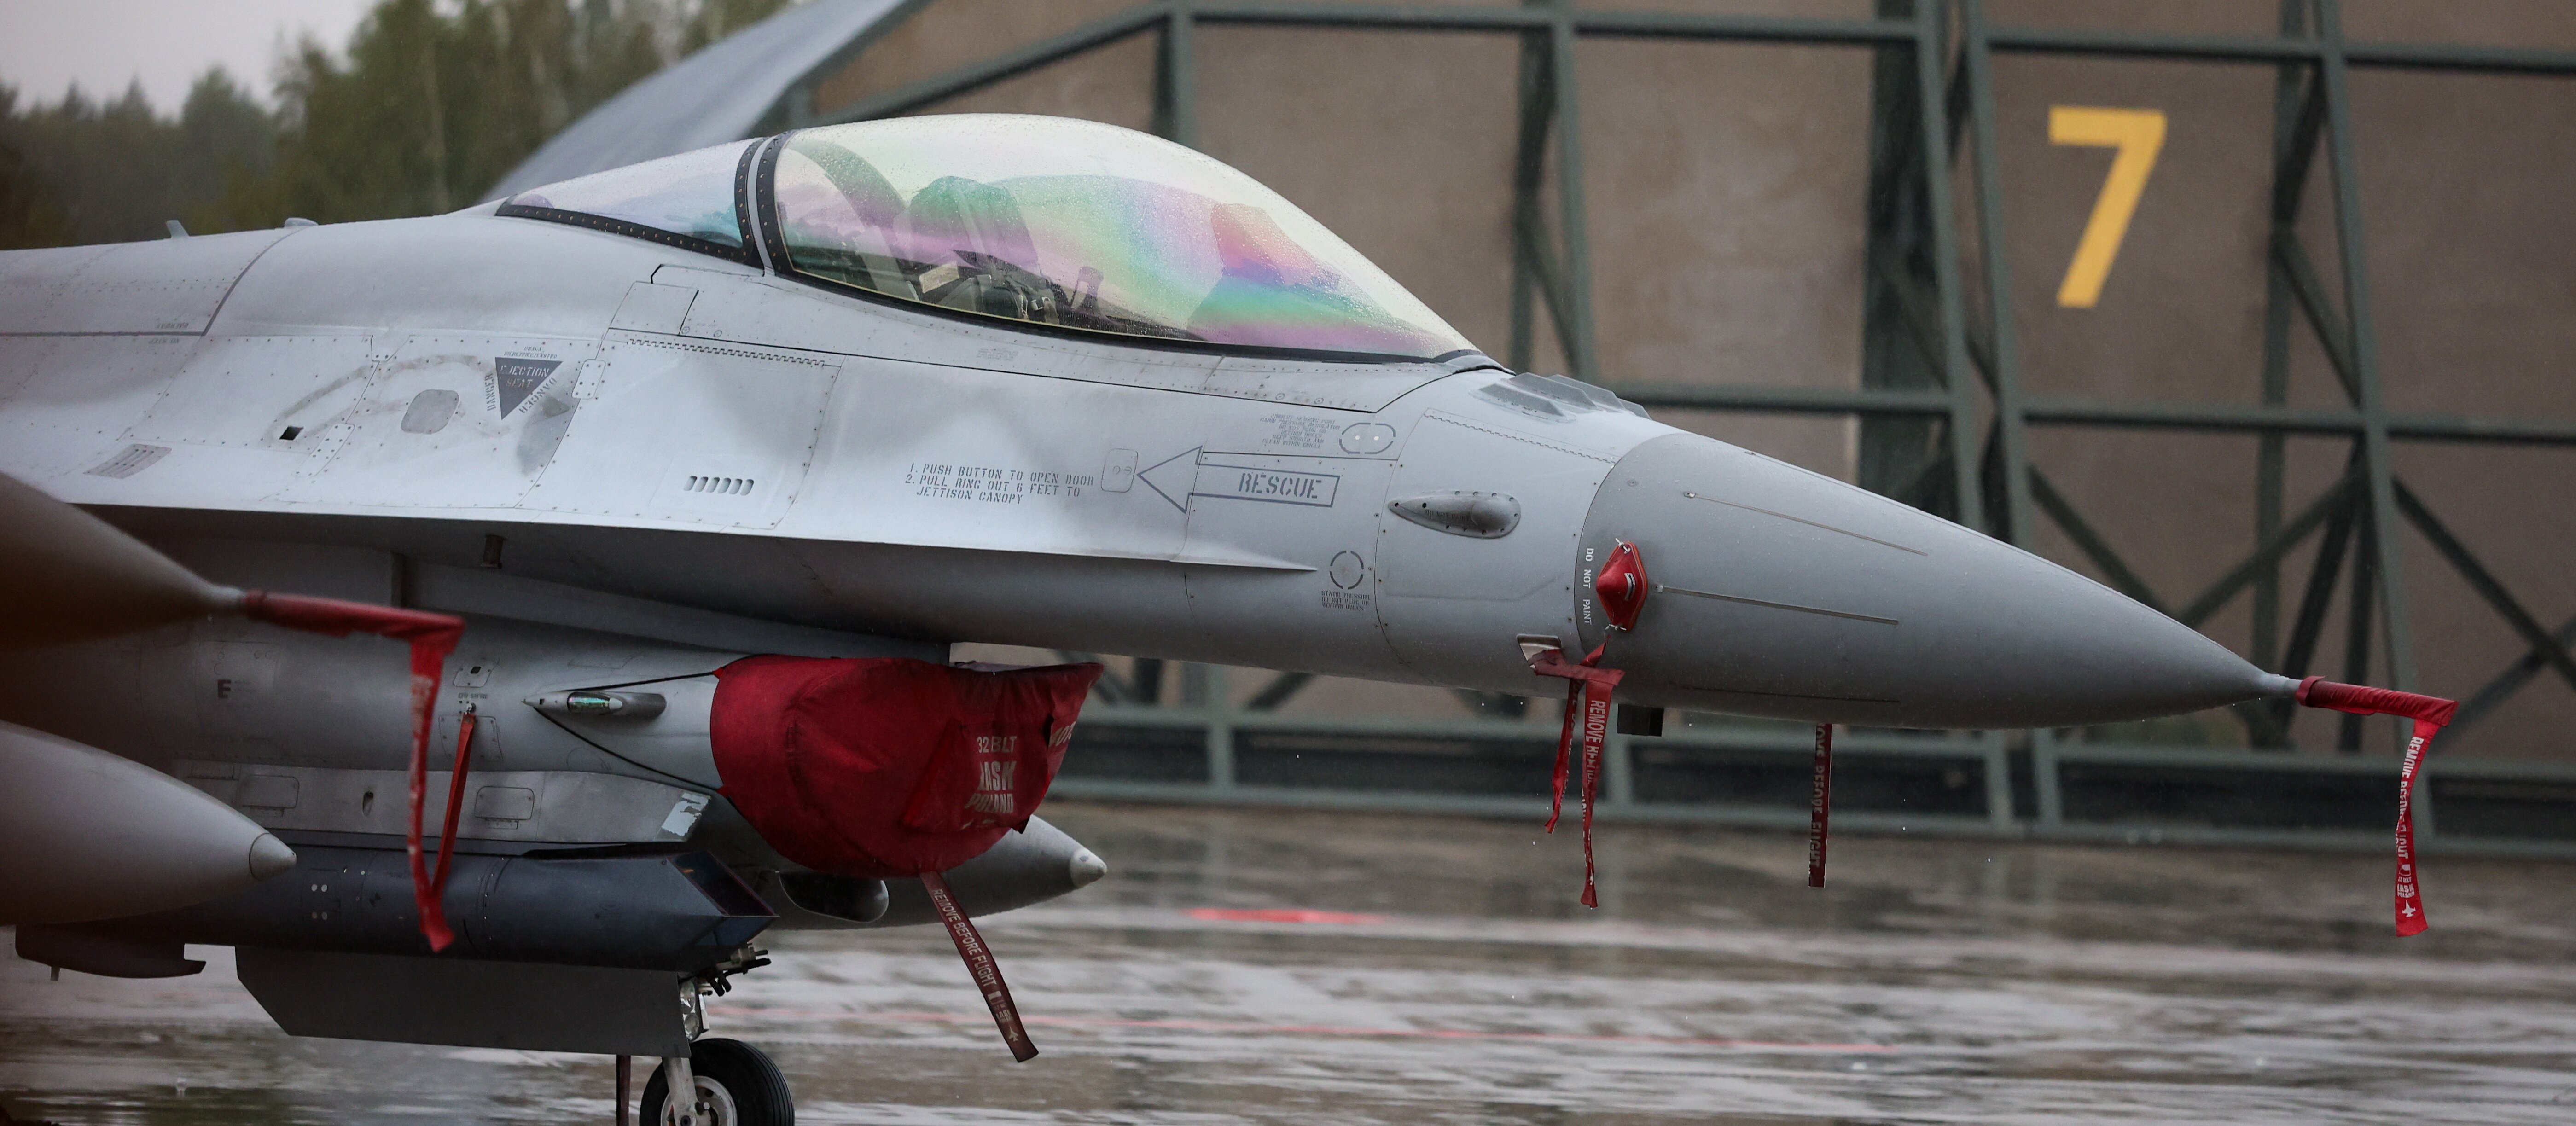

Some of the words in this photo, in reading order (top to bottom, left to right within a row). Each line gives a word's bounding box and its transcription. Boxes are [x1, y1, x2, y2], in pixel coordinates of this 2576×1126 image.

[2048, 105, 2167, 308] 7
[485, 373, 496, 412] DANGER
[519, 377, 557, 413] DANGER
[905, 474, 915, 484] 2.
[919, 474, 948, 487] PULL
[955, 477, 981, 490] RING
[988, 480, 1010, 492] OUT
[1016, 482, 1023, 492] 6
[1029, 484, 1059, 496] FEET
[1066, 486, 1080, 498] TO
[910, 463, 918, 473] 1.
[923, 463, 952, 475] PUSH
[958, 466, 1002, 479] BUTTON
[1010, 470, 1023, 481] TO
[1030, 471, 1059, 484] OPEN
[1065, 474, 1094, 486] DOOR
[1239, 472, 1322, 499] RESCUE
[916, 486, 972, 500] JETTISON
[979, 491, 1023, 505] CANOPY
[1585, 548, 1594, 562] DO
[1583, 569, 1592, 589] NOT
[1582, 599, 1592, 625] PAINT
[1586, 700, 1606, 743] REMOVE
[977, 736, 989, 753] 32
[991, 736, 1017, 753] BLT
[2402, 737, 2425, 778] REMOVE
[965, 793, 1013, 814] POLAND
[2399, 781, 2408, 822] BEFOR
[932, 889, 961, 922] REMOVE
[953, 922, 983, 955] BEFORE
[972, 955, 997, 987] FLIGHT
